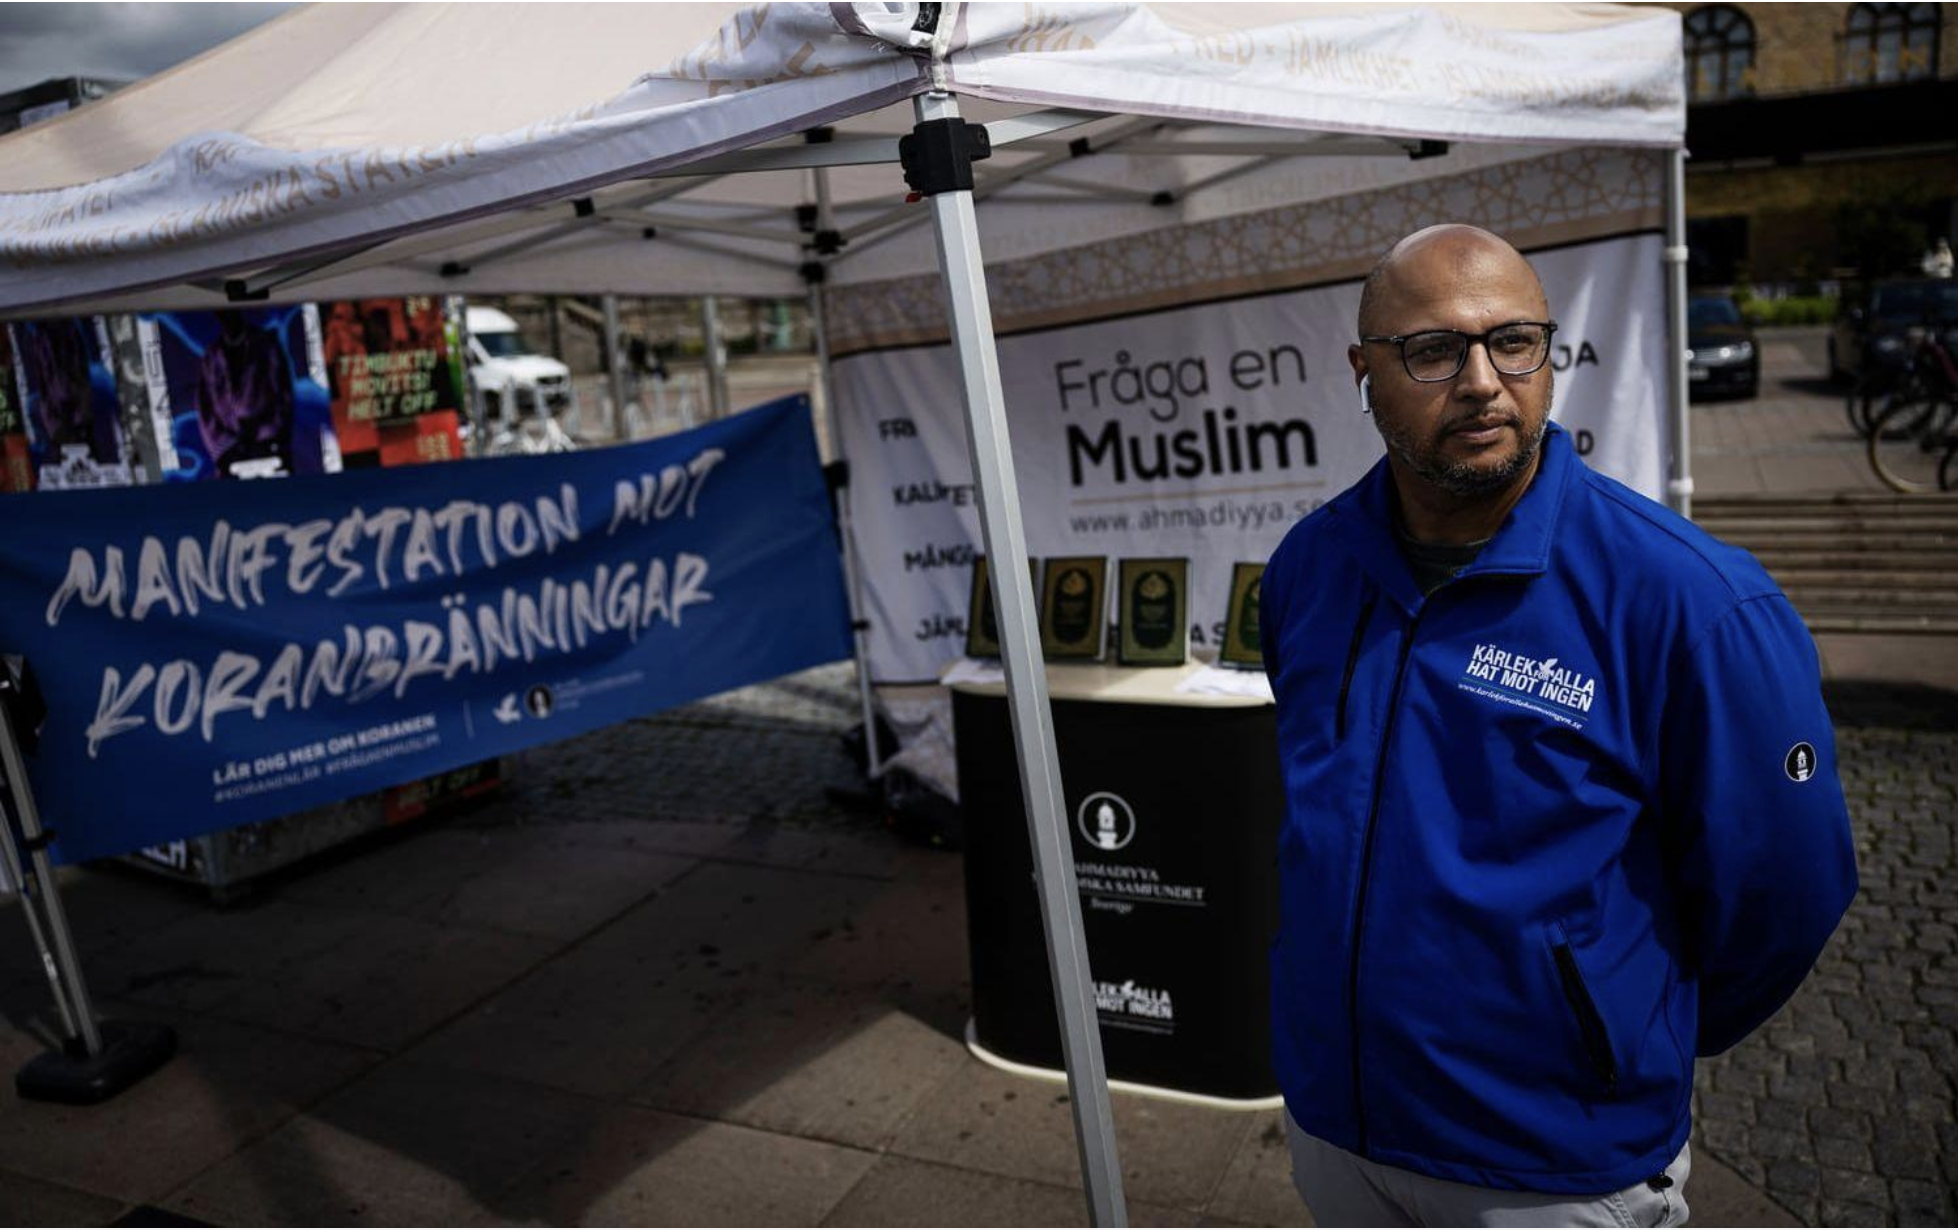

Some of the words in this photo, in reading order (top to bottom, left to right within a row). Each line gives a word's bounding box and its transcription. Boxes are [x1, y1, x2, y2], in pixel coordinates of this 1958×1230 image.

[1054, 349, 1209, 423] Fråga
[1229, 344, 1307, 392] en
[1066, 407, 1318, 487] Muslim
[45, 482, 581, 627] MANIFESTATION
[607, 449, 726, 537] MOT
[85, 552, 714, 760] KORANBRÄNNINGAR
[1465, 660, 1501, 682] HAT
[1500, 670, 1539, 694] MOT
[1538, 681, 1594, 713] INGEN
[1472, 643, 1538, 676] KÄRLEK
[1551, 667, 1596, 697] ALLA
[212, 762, 251, 785] LÄR
[254, 752, 287, 776] DIG
[289, 742, 326, 766] MER
[327, 737, 356, 755] OM
[357, 713, 437, 747] KORANEN
